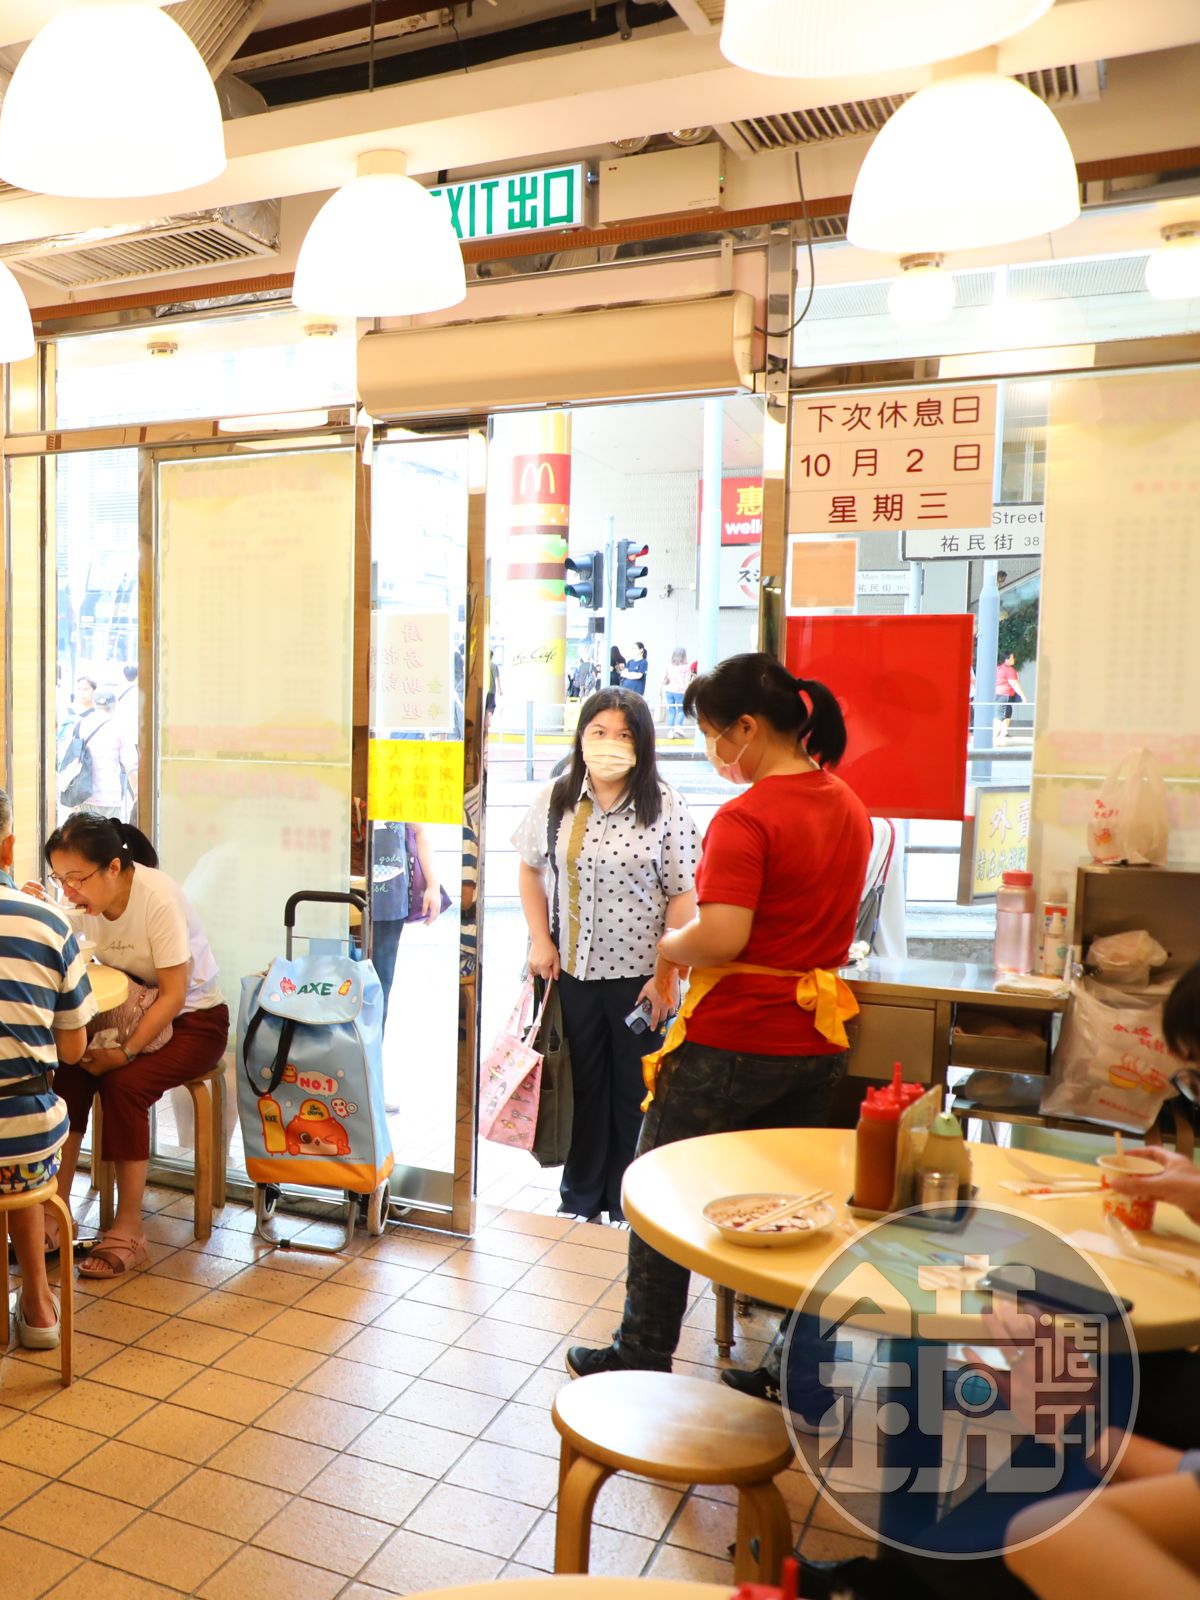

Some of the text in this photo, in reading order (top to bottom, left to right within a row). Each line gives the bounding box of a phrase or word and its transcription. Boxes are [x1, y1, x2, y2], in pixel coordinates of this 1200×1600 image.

[429, 169, 574, 239] XIT 出口
[807, 395, 980, 433] 下次休息日
[828, 491, 949, 524] 星期三
[992, 511, 1044, 524] Street
[940, 534, 1013, 552] 祐民街
[297, 982, 334, 996] AXE
[300, 1077, 333, 1092] NO.1
